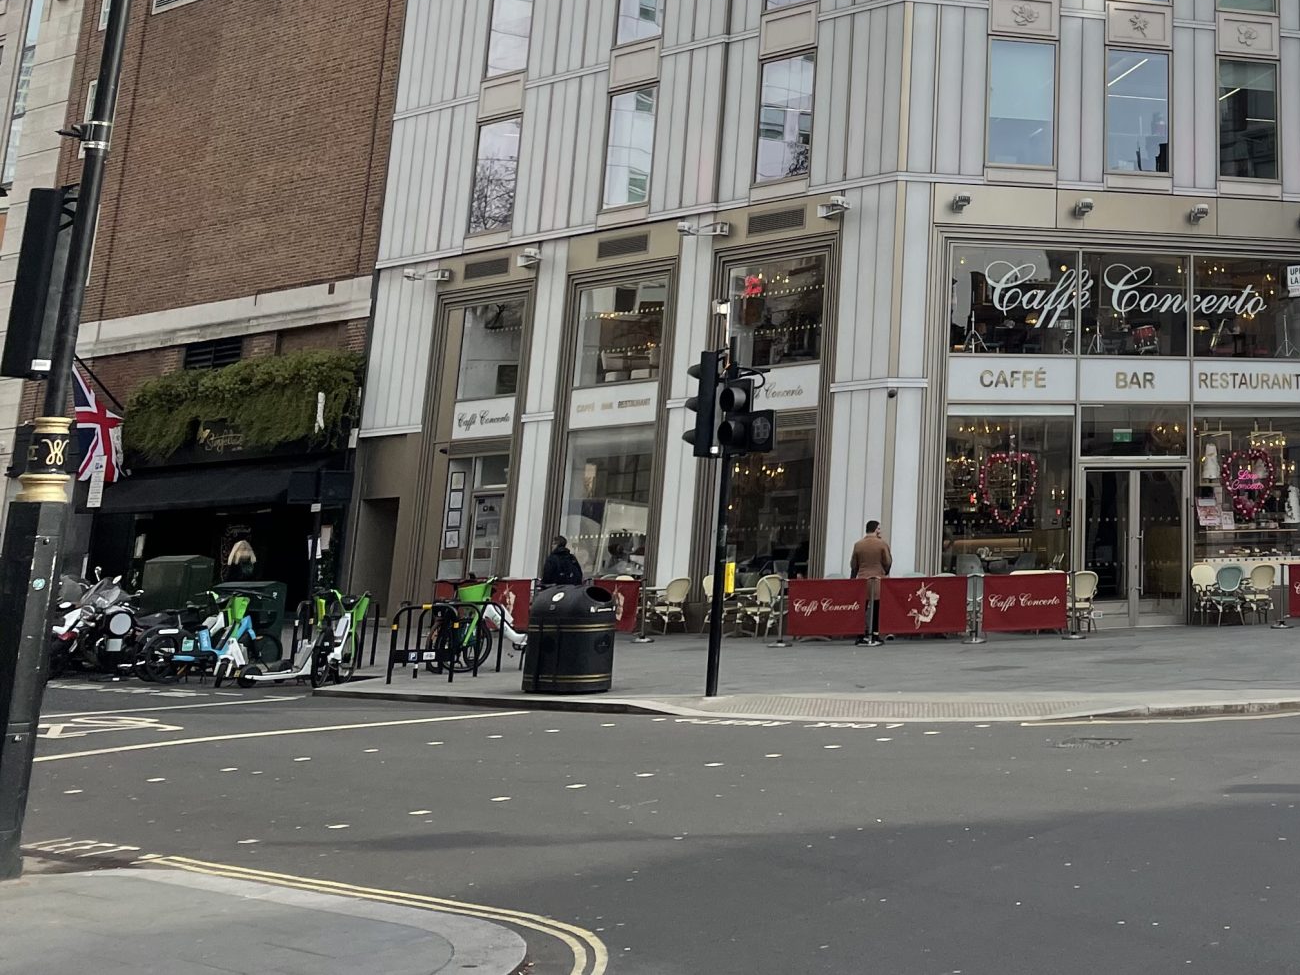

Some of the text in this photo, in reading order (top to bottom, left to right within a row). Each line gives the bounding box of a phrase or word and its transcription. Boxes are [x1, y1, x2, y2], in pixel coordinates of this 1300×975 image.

[1104, 263, 1267, 316] Concerto
[979, 367, 1047, 389] CAFFÉ
[1115, 372, 1155, 389] BAR
[820, 597, 860, 612] Concerto
[1019, 593, 1060, 606] Concerto
